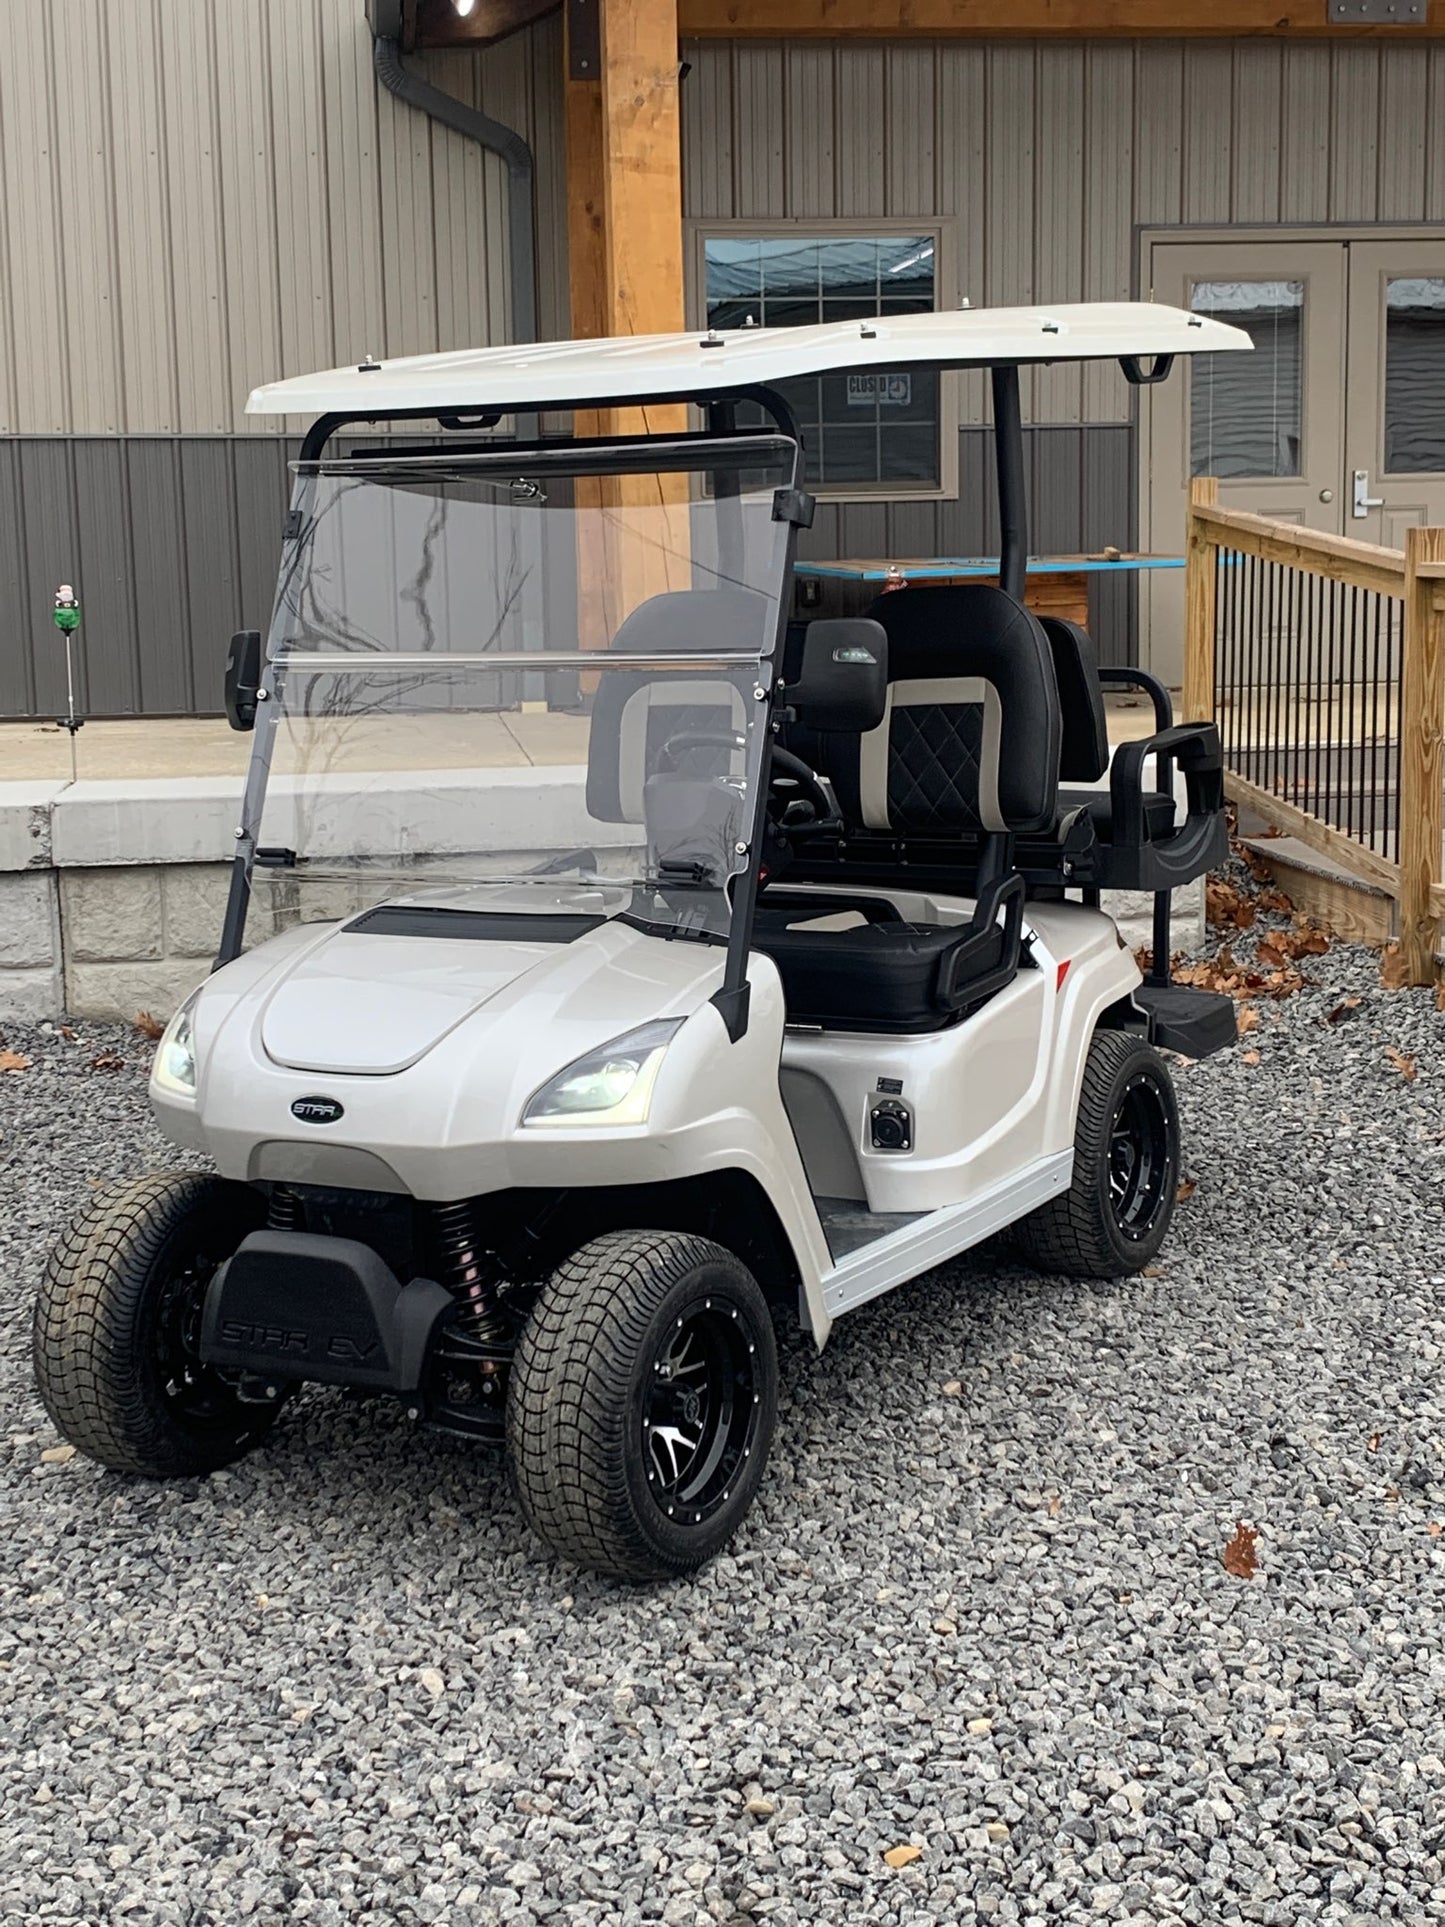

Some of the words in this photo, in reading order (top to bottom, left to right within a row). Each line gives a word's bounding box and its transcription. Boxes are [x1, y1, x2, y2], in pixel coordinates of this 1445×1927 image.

[293, 1103, 336, 1116] STAR
[222, 1320, 309, 1353] STAR
[327, 1336, 379, 1359] EV
